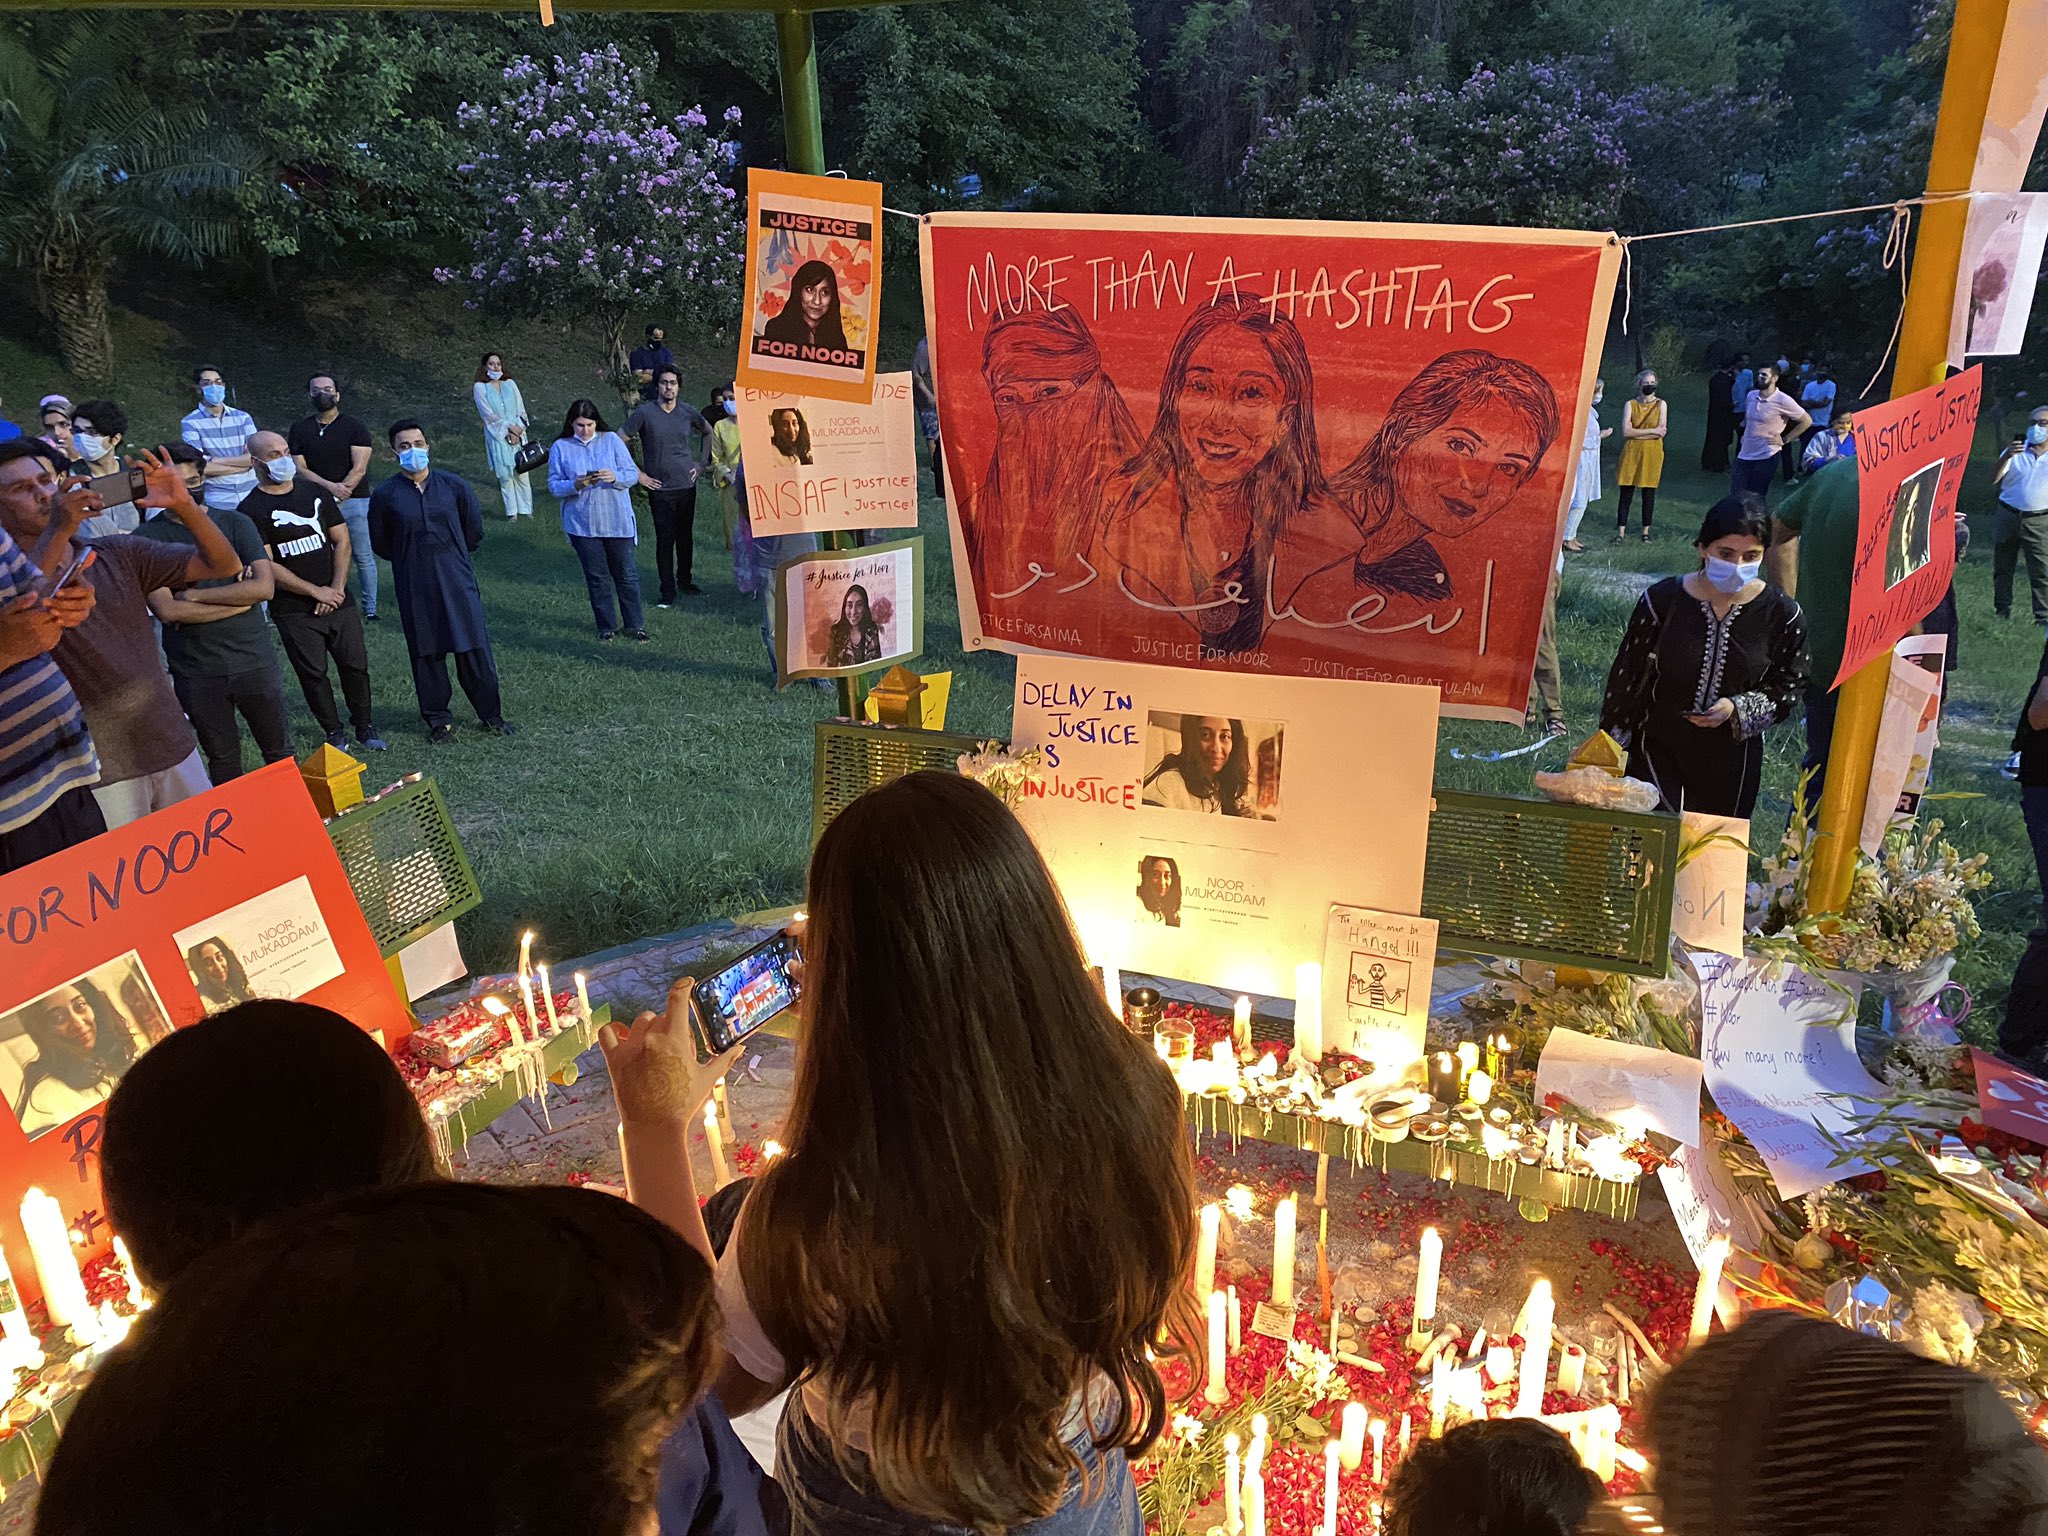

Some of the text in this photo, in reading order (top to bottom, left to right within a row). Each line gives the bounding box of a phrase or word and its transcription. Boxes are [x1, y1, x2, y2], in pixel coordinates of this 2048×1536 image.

[769, 212, 858, 237] JUSTICE
[967, 249, 1534, 334] MORE THAN A HASHTAG
[757, 339, 859, 366] FOR NOOR
[812, 426, 880, 438] MUKADDAM
[829, 416, 861, 427] NOOR
[277, 533, 323, 558] PUMA
[982, 613, 1082, 646] STICEFORSAIMA
[1132, 635, 1271, 669] JUSTICEFORNOOR
[1102, 691, 1134, 712] IN
[1047, 713, 1140, 746] JUSTICE
[87, 808, 247, 922] NOOR
[1184, 886, 1266, 907] MUKADDAM
[1207, 877, 1245, 892] NOOR
[242, 921, 319, 966] MUKADDAM
[257, 919, 296, 944] NOOR
[1745, 1053, 1779, 1075] many
